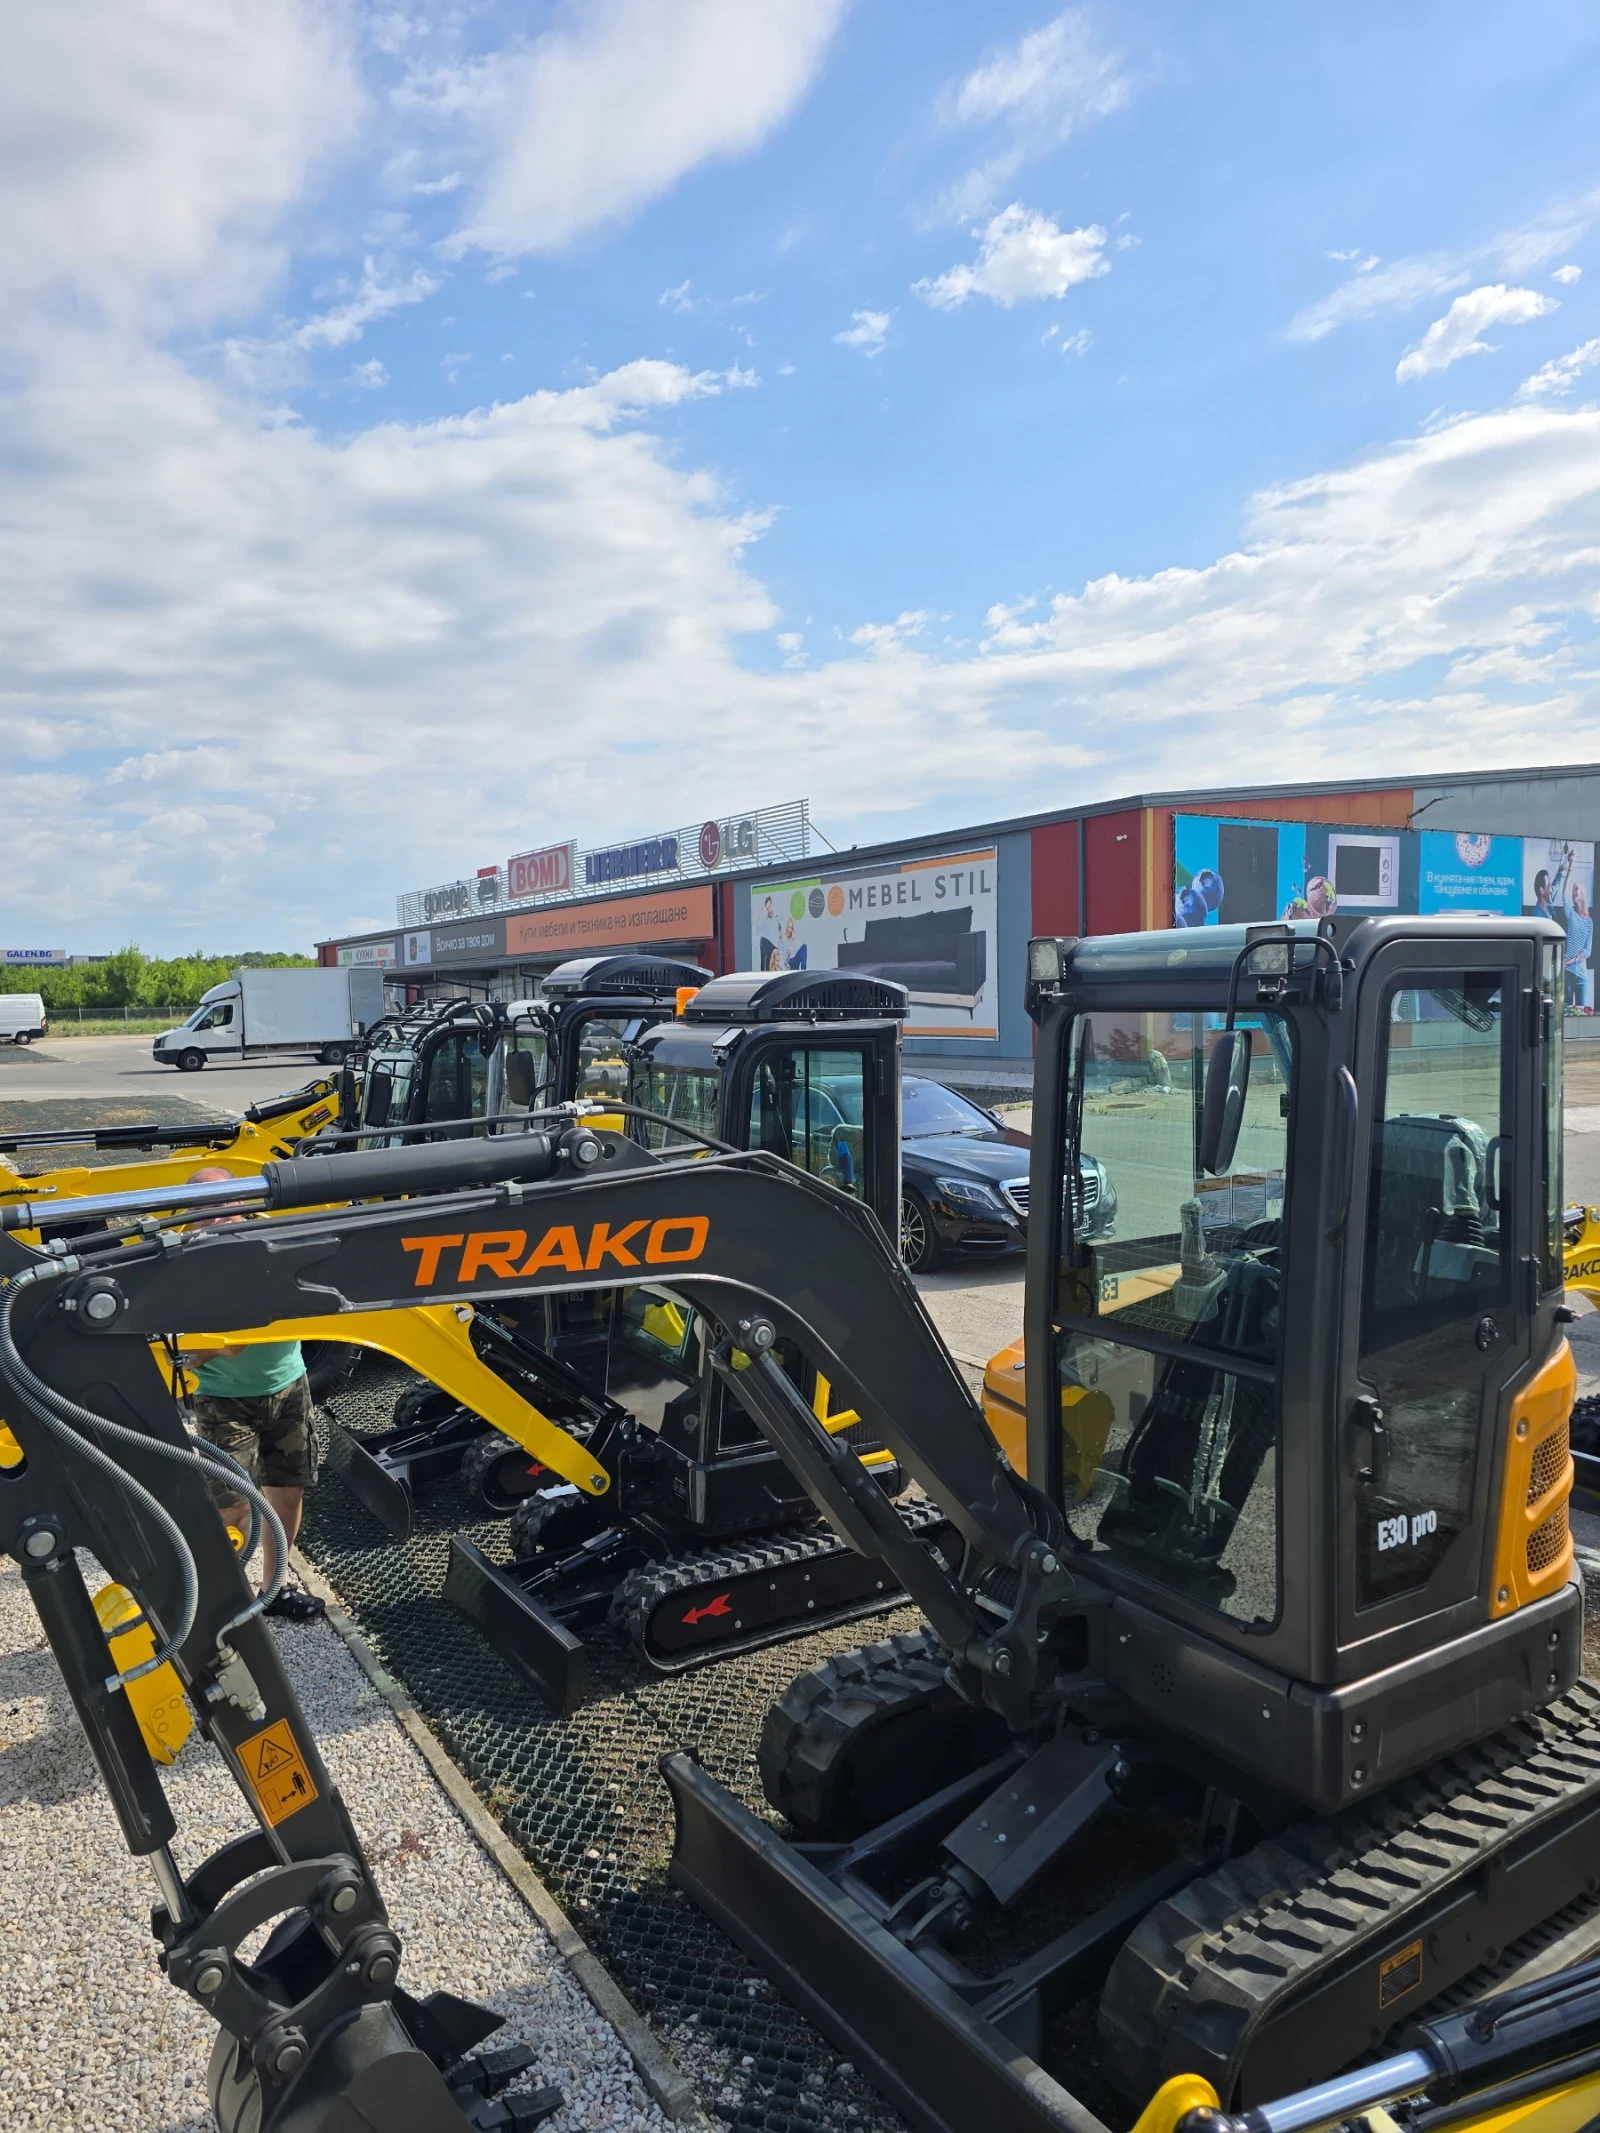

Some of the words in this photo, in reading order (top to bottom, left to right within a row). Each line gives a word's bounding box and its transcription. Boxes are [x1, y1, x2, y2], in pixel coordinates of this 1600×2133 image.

[722, 820, 755, 858] LG
[516, 854, 560, 891] BOMI
[585, 838, 679, 884] LIEBHERR
[425, 880, 470, 921] gorenje
[849, 882, 921, 909] MEBEL
[935, 870, 991, 899] STIL
[436, 937, 457, 952] Всичко
[458, 937, 465, 949] за
[466, 935, 480, 948] твоя
[481, 933, 495, 949] дом
[519, 924, 537, 943] Купи
[539, 921, 568, 938] мебели
[570, 922, 576, 934] и
[577, 916, 613, 933] техника
[614, 914, 626, 929] на
[629, 906, 688, 926] изплащане
[7, 950, 52, 958] GALEN.BG
[401, 1216, 710, 1287] TRAKO
[1378, 1514, 1408, 1551] E30
[1412, 1510, 1437, 1546] pro
